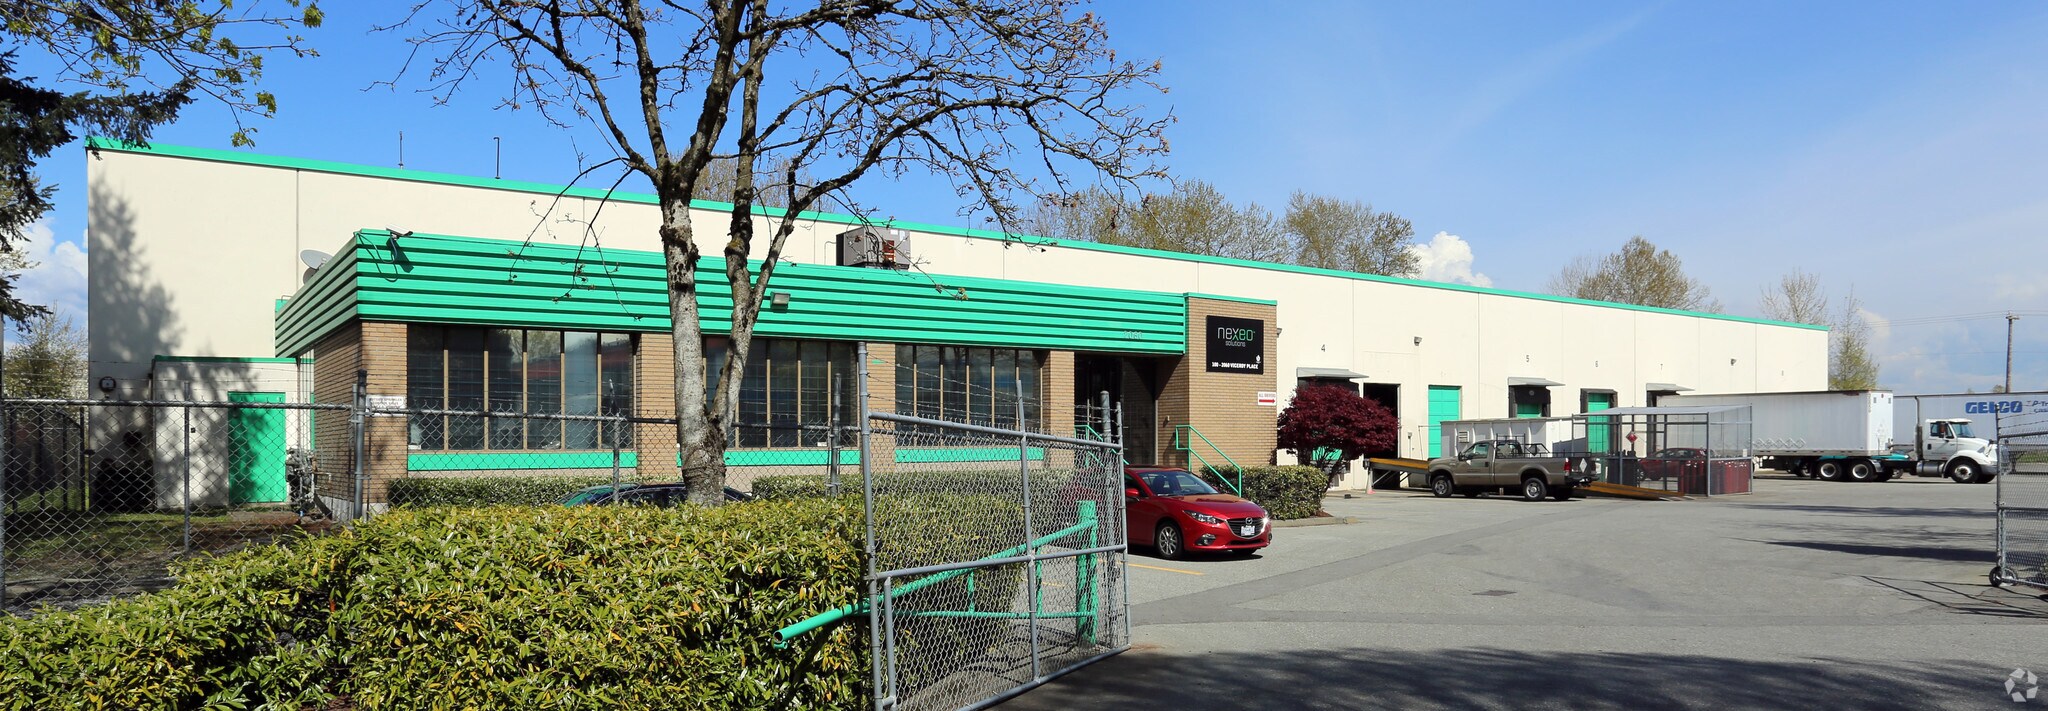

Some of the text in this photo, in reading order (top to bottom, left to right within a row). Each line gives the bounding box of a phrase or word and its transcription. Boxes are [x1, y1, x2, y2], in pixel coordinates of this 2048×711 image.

[1218, 327, 1253, 341] nexeo
[1321, 344, 1326, 352] 4
[1525, 354, 1530, 363] 5
[1965, 400, 2022, 413] GELCO
